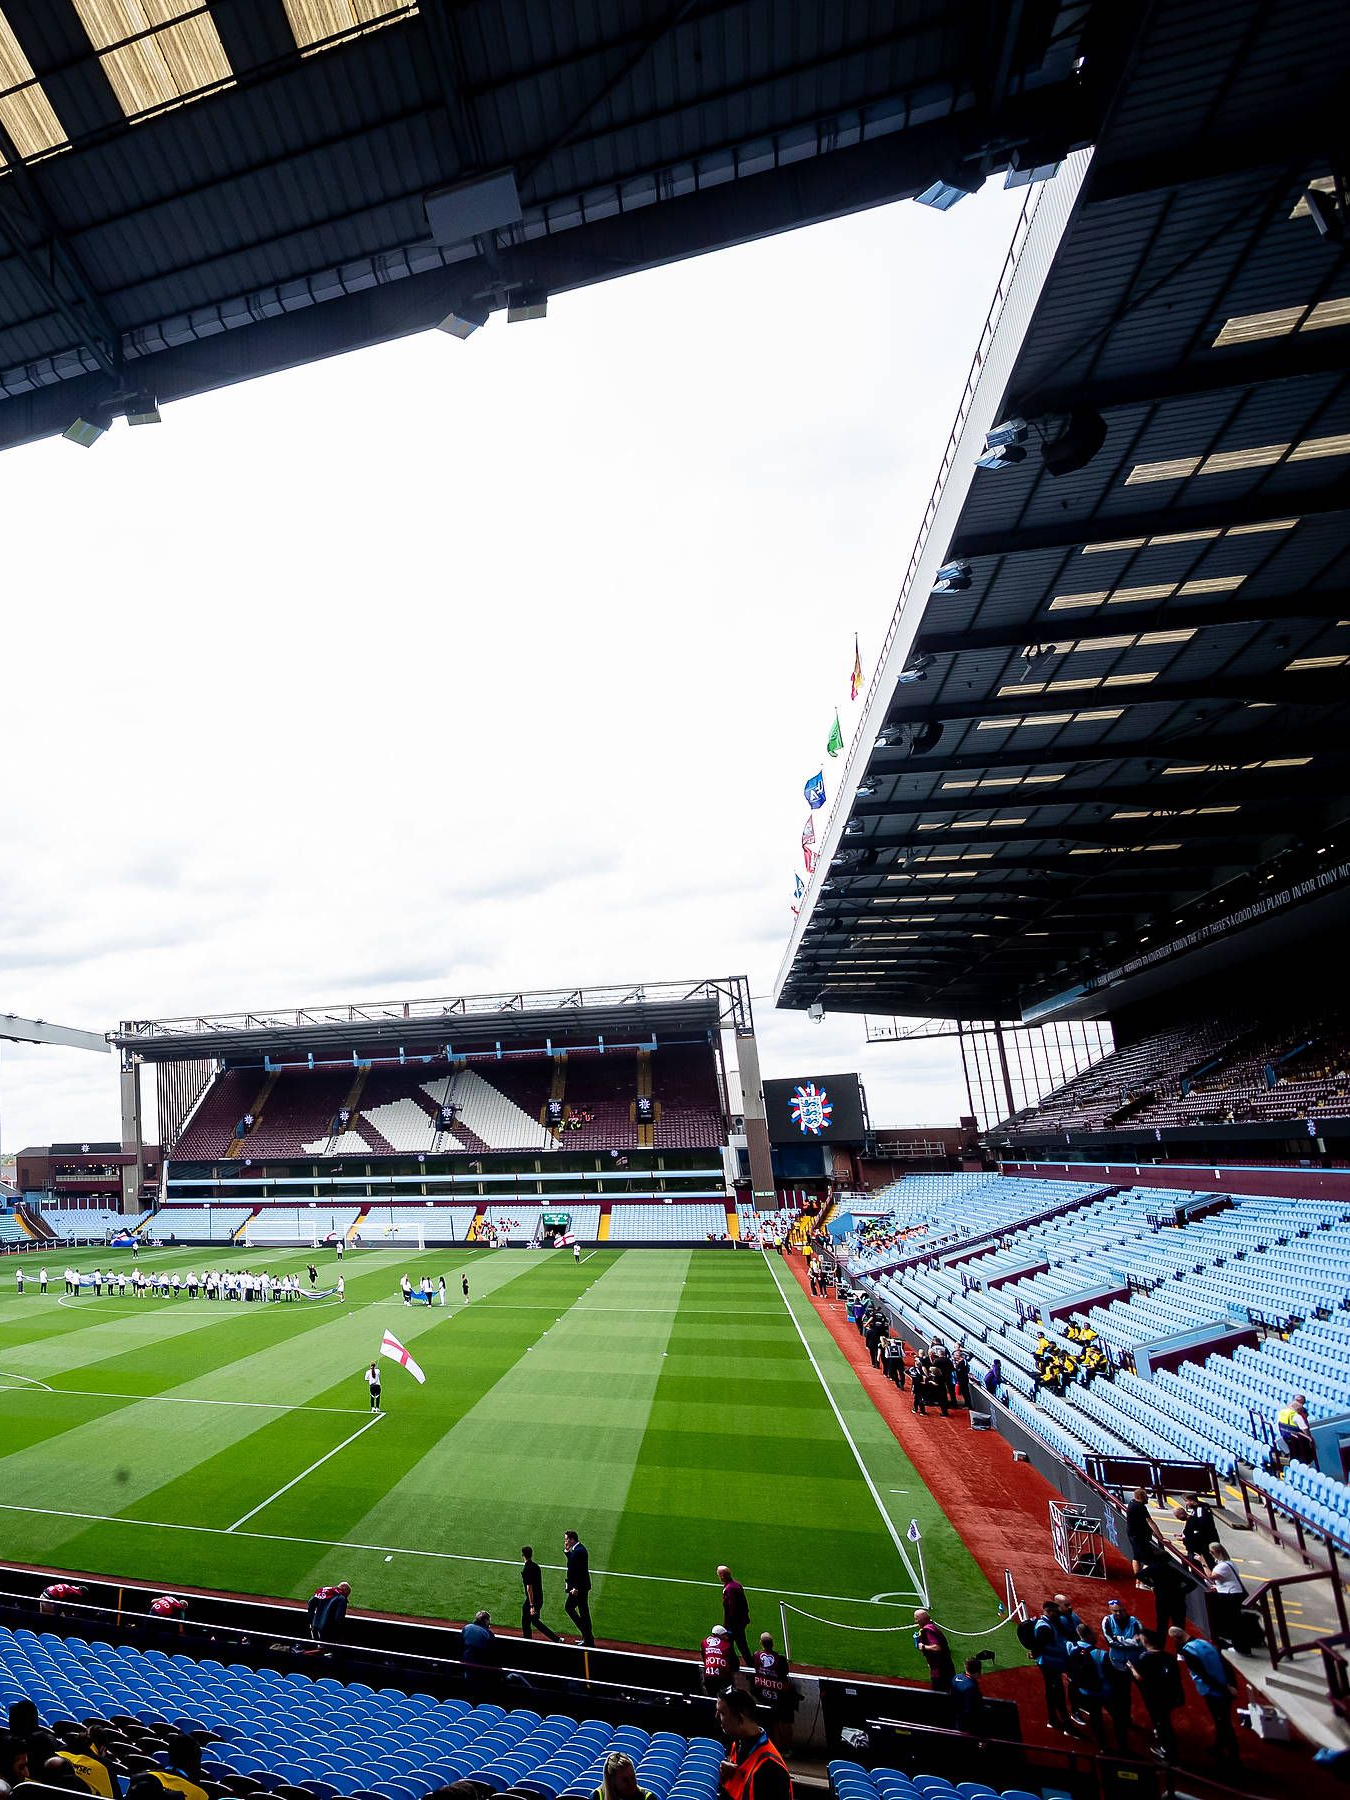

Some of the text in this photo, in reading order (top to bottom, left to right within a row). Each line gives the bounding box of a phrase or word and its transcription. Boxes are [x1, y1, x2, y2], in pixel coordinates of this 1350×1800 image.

[1172, 936, 1188, 951] DOWN
[1209, 917, 1231, 934] THERE'S
[1235, 907, 1252, 924] GOOD
[1251, 900, 1267, 917] BALL
[1266, 890, 1291, 910] PLAYED
[1292, 885, 1301, 899] IN
[1300, 878, 1316, 894] FOR
[1316, 868, 1338, 888] TONY
[705, 1666, 720, 1676] 414
[754, 1676, 783, 1690] PHOTO
[762, 1689, 778, 1700] 653
